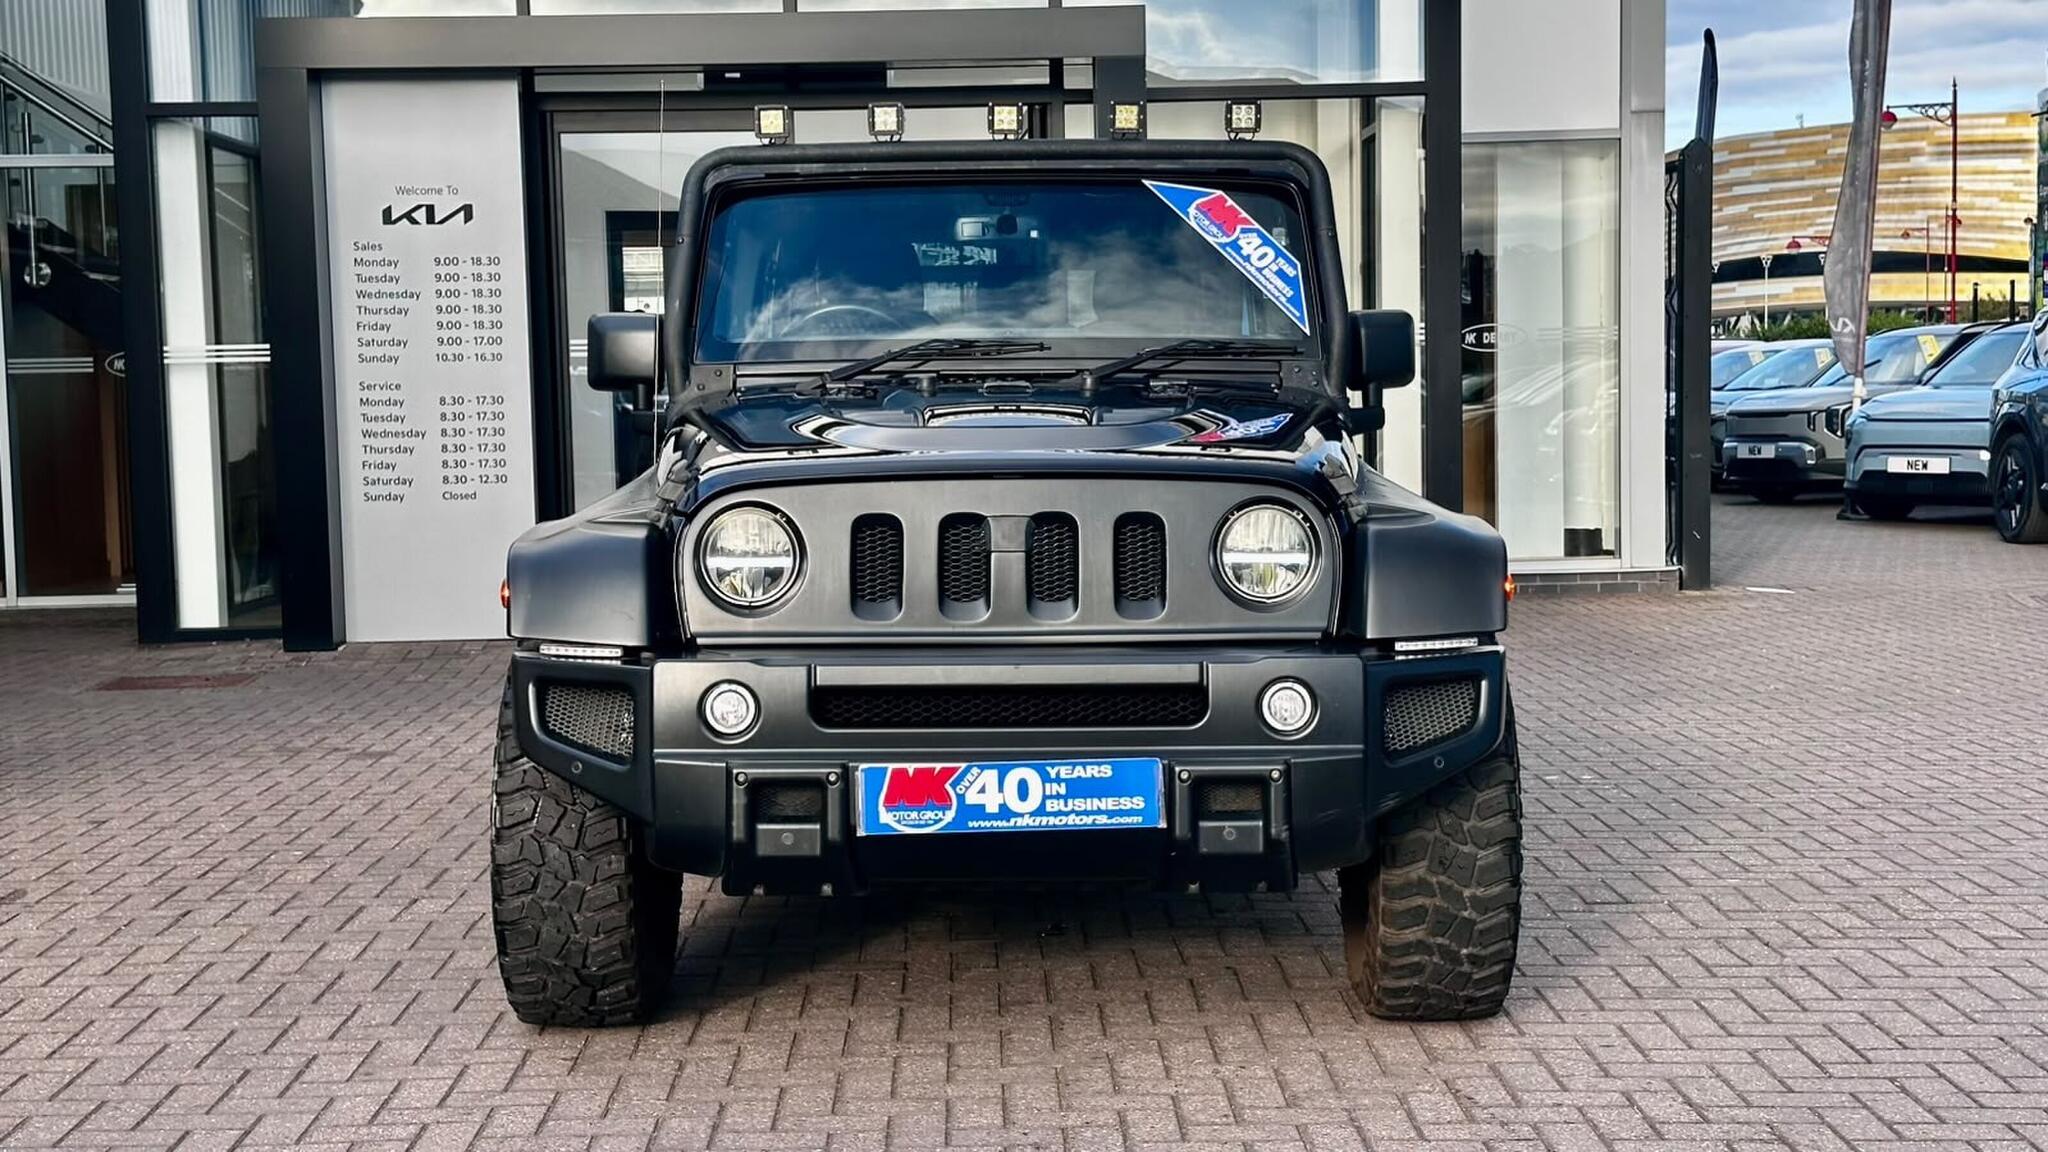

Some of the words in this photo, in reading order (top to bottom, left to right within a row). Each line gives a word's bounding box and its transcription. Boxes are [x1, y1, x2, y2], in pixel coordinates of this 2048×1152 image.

[395, 186, 443, 196] Welcome
[446, 185, 458, 195] To
[382, 203, 474, 226] KIA
[1196, 194, 1255, 235] NK
[353, 241, 383, 251] Sales
[1237, 237, 1276, 268] 40
[354, 257, 399, 269] Monday
[434, 257, 459, 266] 9.00
[470, 256, 500, 266] 18.30
[354, 273, 400, 285] Tuesday
[434, 272, 460, 283] 9.00
[471, 272, 501, 282] 18.30
[355, 289, 421, 301] Wednesday
[435, 289, 460, 299] 9.00
[471, 288, 502, 298] 18.30
[356, 305, 409, 317] Thursday
[435, 304, 461, 315] 9.00
[472, 304, 502, 314] 18.30
[356, 321, 391, 333] Friday
[436, 320, 462, 330] 9.00
[473, 320, 503, 330] 18.30
[357, 337, 408, 349] Saturday
[437, 336, 462, 346] 9.00
[473, 336, 503, 346] 17.00
[1464, 332, 1477, 345] NK
[113, 358, 125, 370] NK
[358, 353, 399, 365] Sunday
[436, 353, 464, 362] 10.30
[474, 352, 503, 362] 16.30
[359, 381, 401, 391] Service
[360, 396, 405, 409] Monday
[439, 396, 465, 406] 8.30
[476, 395, 504, 406] 17.30
[360, 413, 406, 425] Tuesday
[440, 411, 465, 422] 8.30
[476, 411, 505, 421] 17.30
[361, 428, 427, 440] Wednesday
[441, 428, 466, 438] 8.30
[477, 427, 505, 437] 17.30
[362, 444, 415, 456] Thursday
[441, 443, 466, 453] 8.30
[477, 442, 506, 453] 17.30
[1748, 444, 1762, 456] NEW
[362, 460, 397, 472] Friday
[441, 459, 467, 469] 8.30
[478, 458, 506, 469] 17.30
[1906, 459, 1929, 471] NEW
[363, 476, 414, 488] Saturday
[442, 475, 467, 485] 8.30
[478, 474, 508, 484] 12.30
[364, 492, 405, 504] Sunday
[442, 491, 477, 501] Closed
[1045, 764, 1113, 779] YEARS
[884, 766, 962, 807] NK
[964, 767, 1043, 814] 40
[1045, 782, 1066, 796] IN
[1045, 796, 1146, 812] BUSINESS
[967, 813, 1143, 828] www.nkmotors.com
